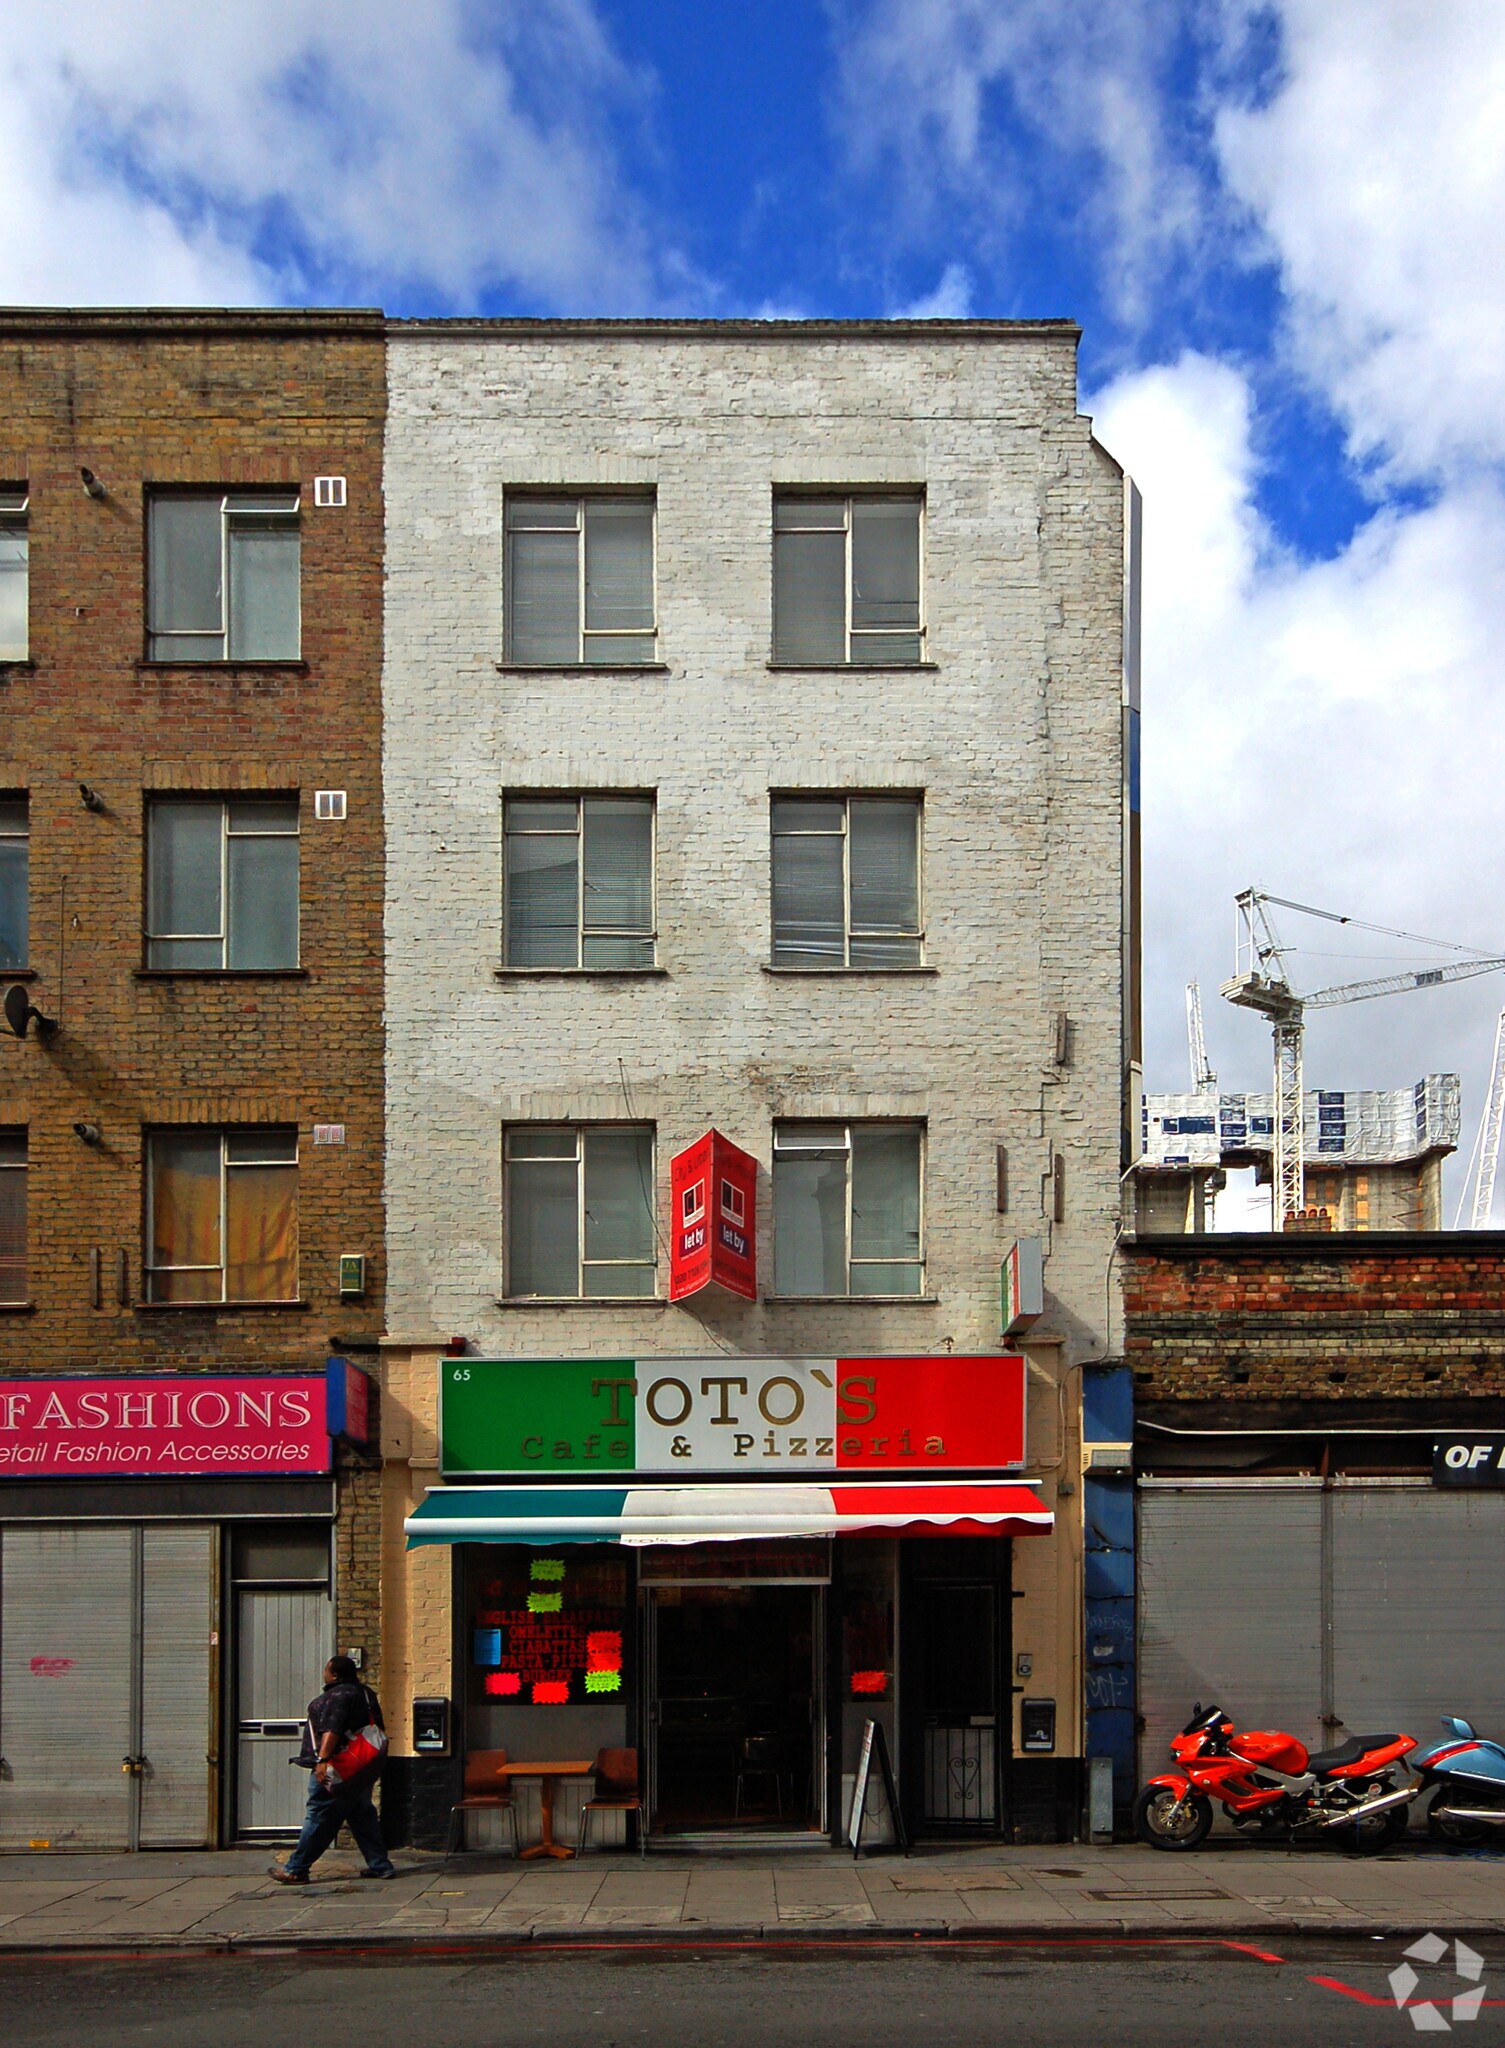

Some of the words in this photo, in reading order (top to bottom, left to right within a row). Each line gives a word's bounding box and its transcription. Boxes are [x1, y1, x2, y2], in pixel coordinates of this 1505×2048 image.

[684, 1233, 695, 1249] let
[695, 1228, 704, 1244] by
[723, 1225, 734, 1243] let
[733, 1231, 745, 1253] by
[453, 1369, 471, 1381] 65
[0, 1391, 311, 1429] FASHIONS
[54, 1442, 151, 1462] Fashion
[157, 1440, 310, 1461] Accessories
[521, 1435, 630, 1459] Cafe
[670, 1435, 692, 1457] &
[733, 1431, 947, 1456] Pizzeria
[1445, 1445, 1493, 1468] OF
[509, 1625, 586, 1639] OMELETTES
[509, 1640, 586, 1653] CIABATTAS
[523, 1670, 573, 1683] BURGER
